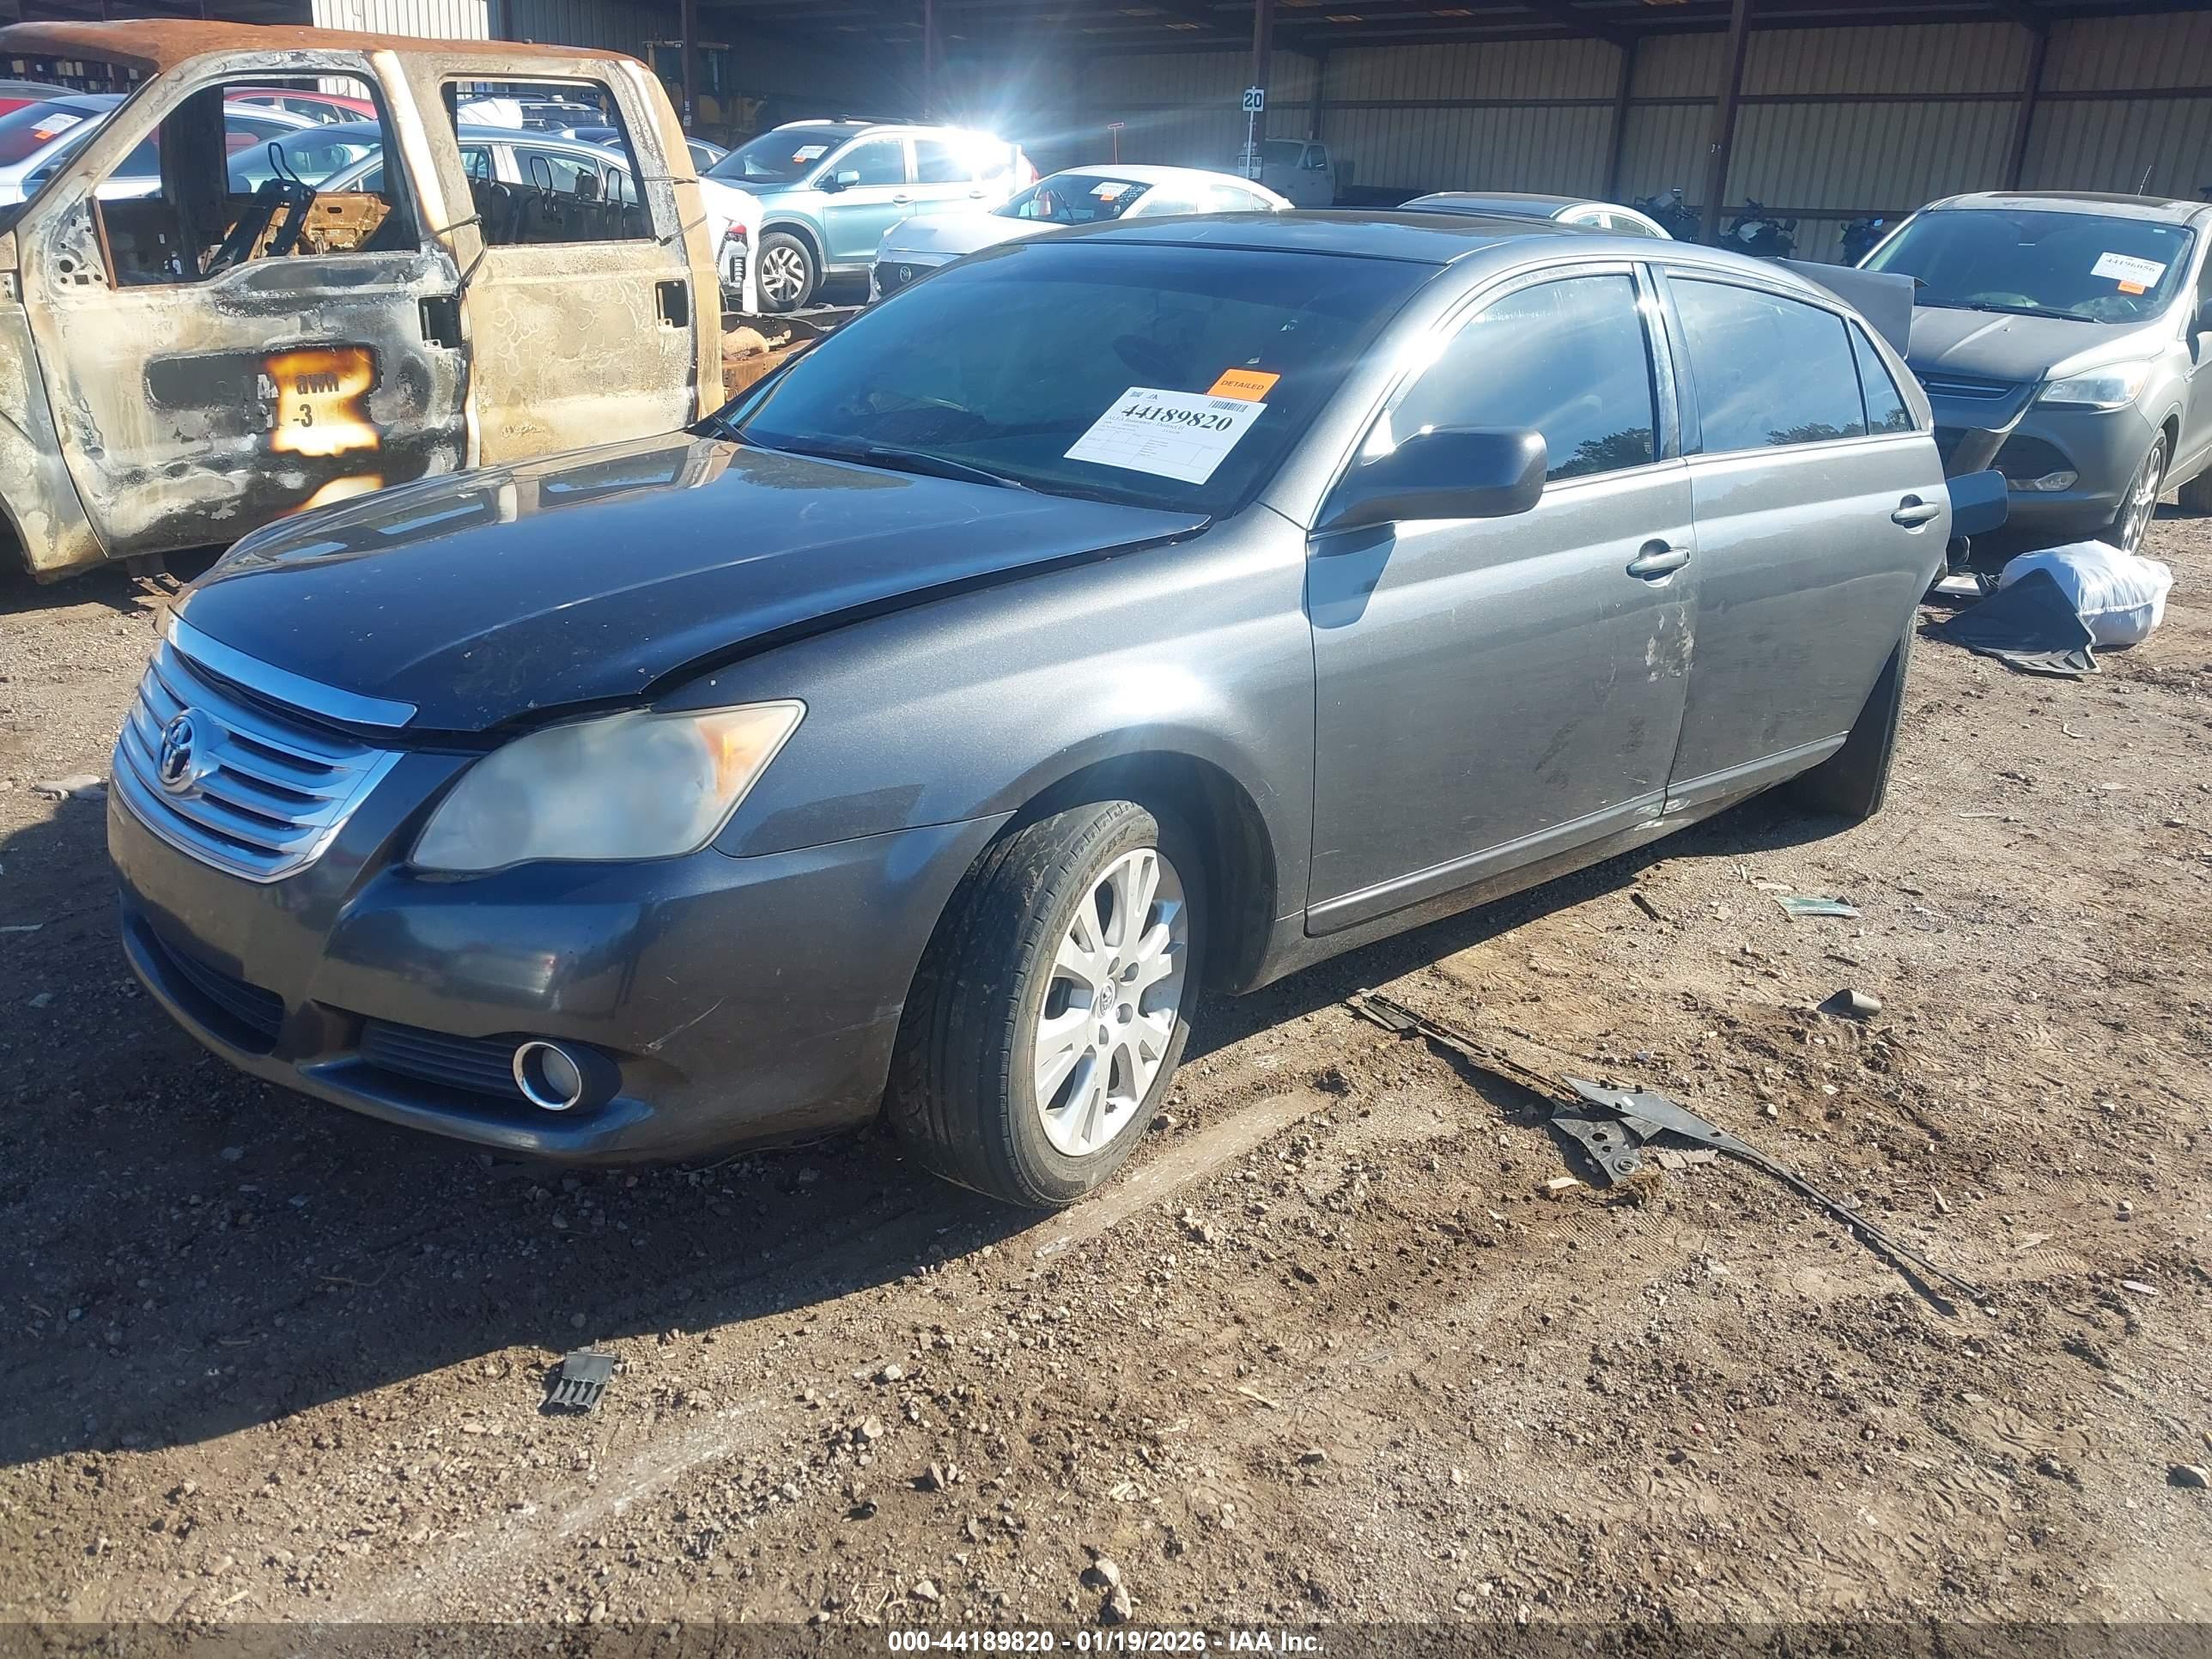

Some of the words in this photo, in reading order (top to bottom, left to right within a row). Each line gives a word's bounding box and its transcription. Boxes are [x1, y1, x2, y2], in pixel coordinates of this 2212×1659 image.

[1244, 92, 1262, 108] 20
[1220, 380, 1265, 391] DETAILED
[1121, 404, 1233, 431] 44189820
